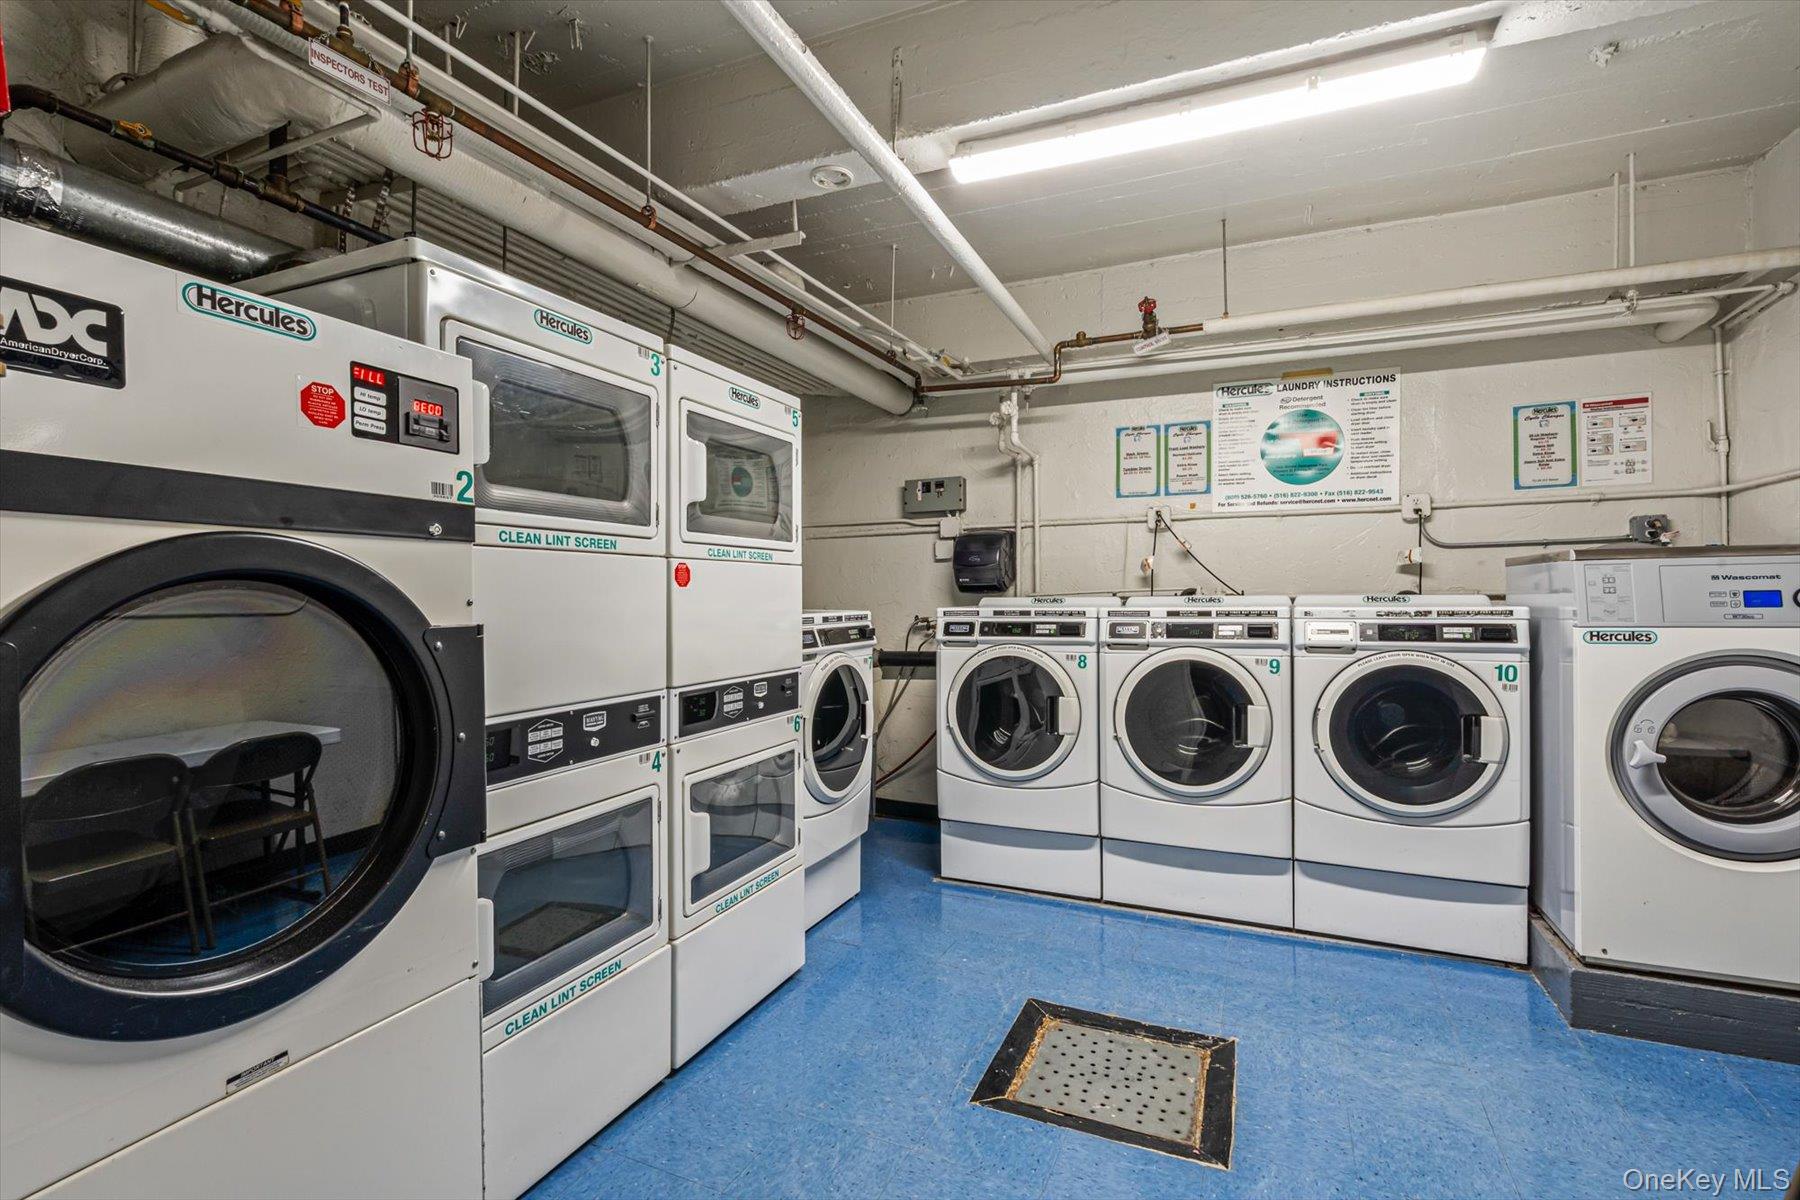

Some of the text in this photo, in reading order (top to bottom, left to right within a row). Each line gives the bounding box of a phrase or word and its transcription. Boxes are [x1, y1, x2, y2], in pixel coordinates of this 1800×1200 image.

[310, 48, 388, 96] INSPECTORS TEST
[196, 284, 308, 336] Hercules
[540, 310, 588, 341] Hercules
[0, 337, 106, 366] AmericanDryerCorp.
[650, 353, 660, 376] 3
[311, 384, 334, 395] STOP
[1276, 380, 1320, 392] LAUNDRY
[1323, 374, 1396, 388] INSTRUCTIONS
[368, 393, 380, 402] temp
[731, 387, 759, 406] Hercules
[1292, 394, 1323, 403] Detergent
[370, 423, 385, 431] Press
[792, 410, 798, 427] 5
[456, 470, 474, 503] 2
[499, 530, 617, 550] CLEAN LINT SCREEN
[707, 548, 773, 561] CLEAN LINT SCREEN
[1590, 631, 1652, 642] Hercules
[868, 656, 873, 670] 7
[1078, 654, 1087, 669] 8
[1269, 658, 1280, 674] 9
[1358, 658, 1373, 667] PLEASE
[1494, 664, 1518, 682] 10
[794, 715, 800, 732] 6
[652, 751, 662, 772] 4
[716, 870, 780, 913] CLEAN LINT SCREEN
[505, 960, 621, 1035] CLEAN LINT SCREEN
